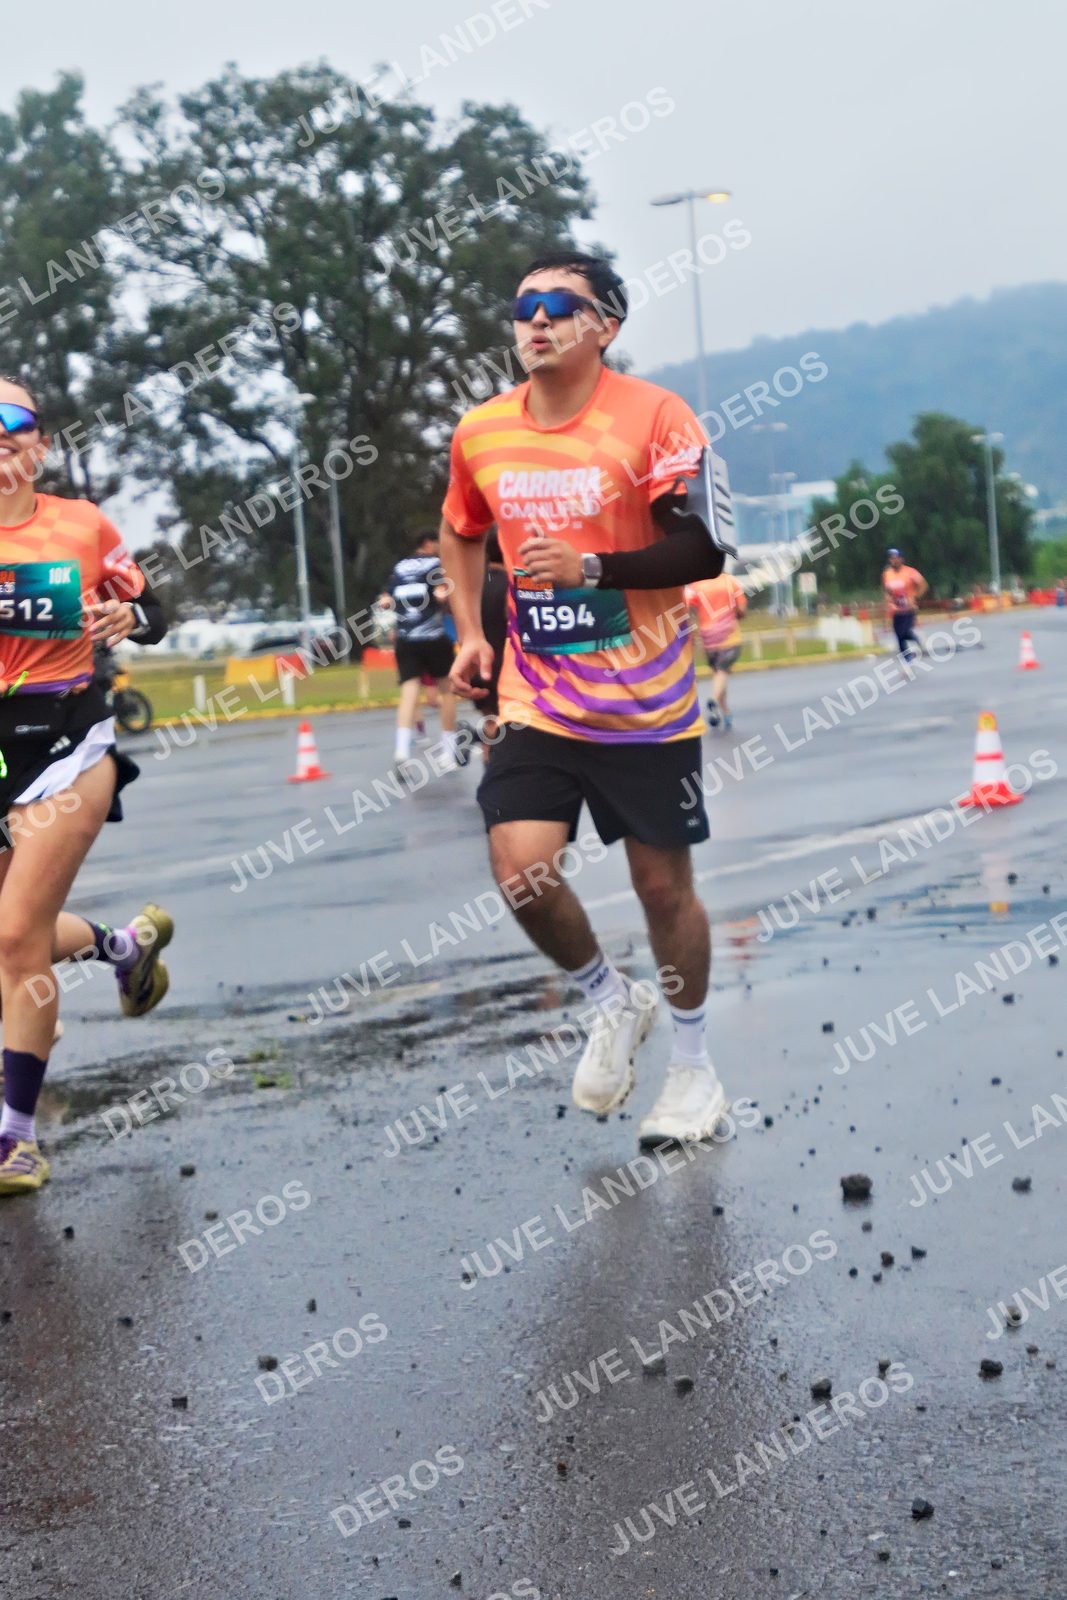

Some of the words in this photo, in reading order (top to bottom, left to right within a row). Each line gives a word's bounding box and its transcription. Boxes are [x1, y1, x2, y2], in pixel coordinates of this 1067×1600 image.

[49, 566, 71, 584] 10K
[0, 597, 53, 620] 512
[528, 603, 596, 631] 1594
